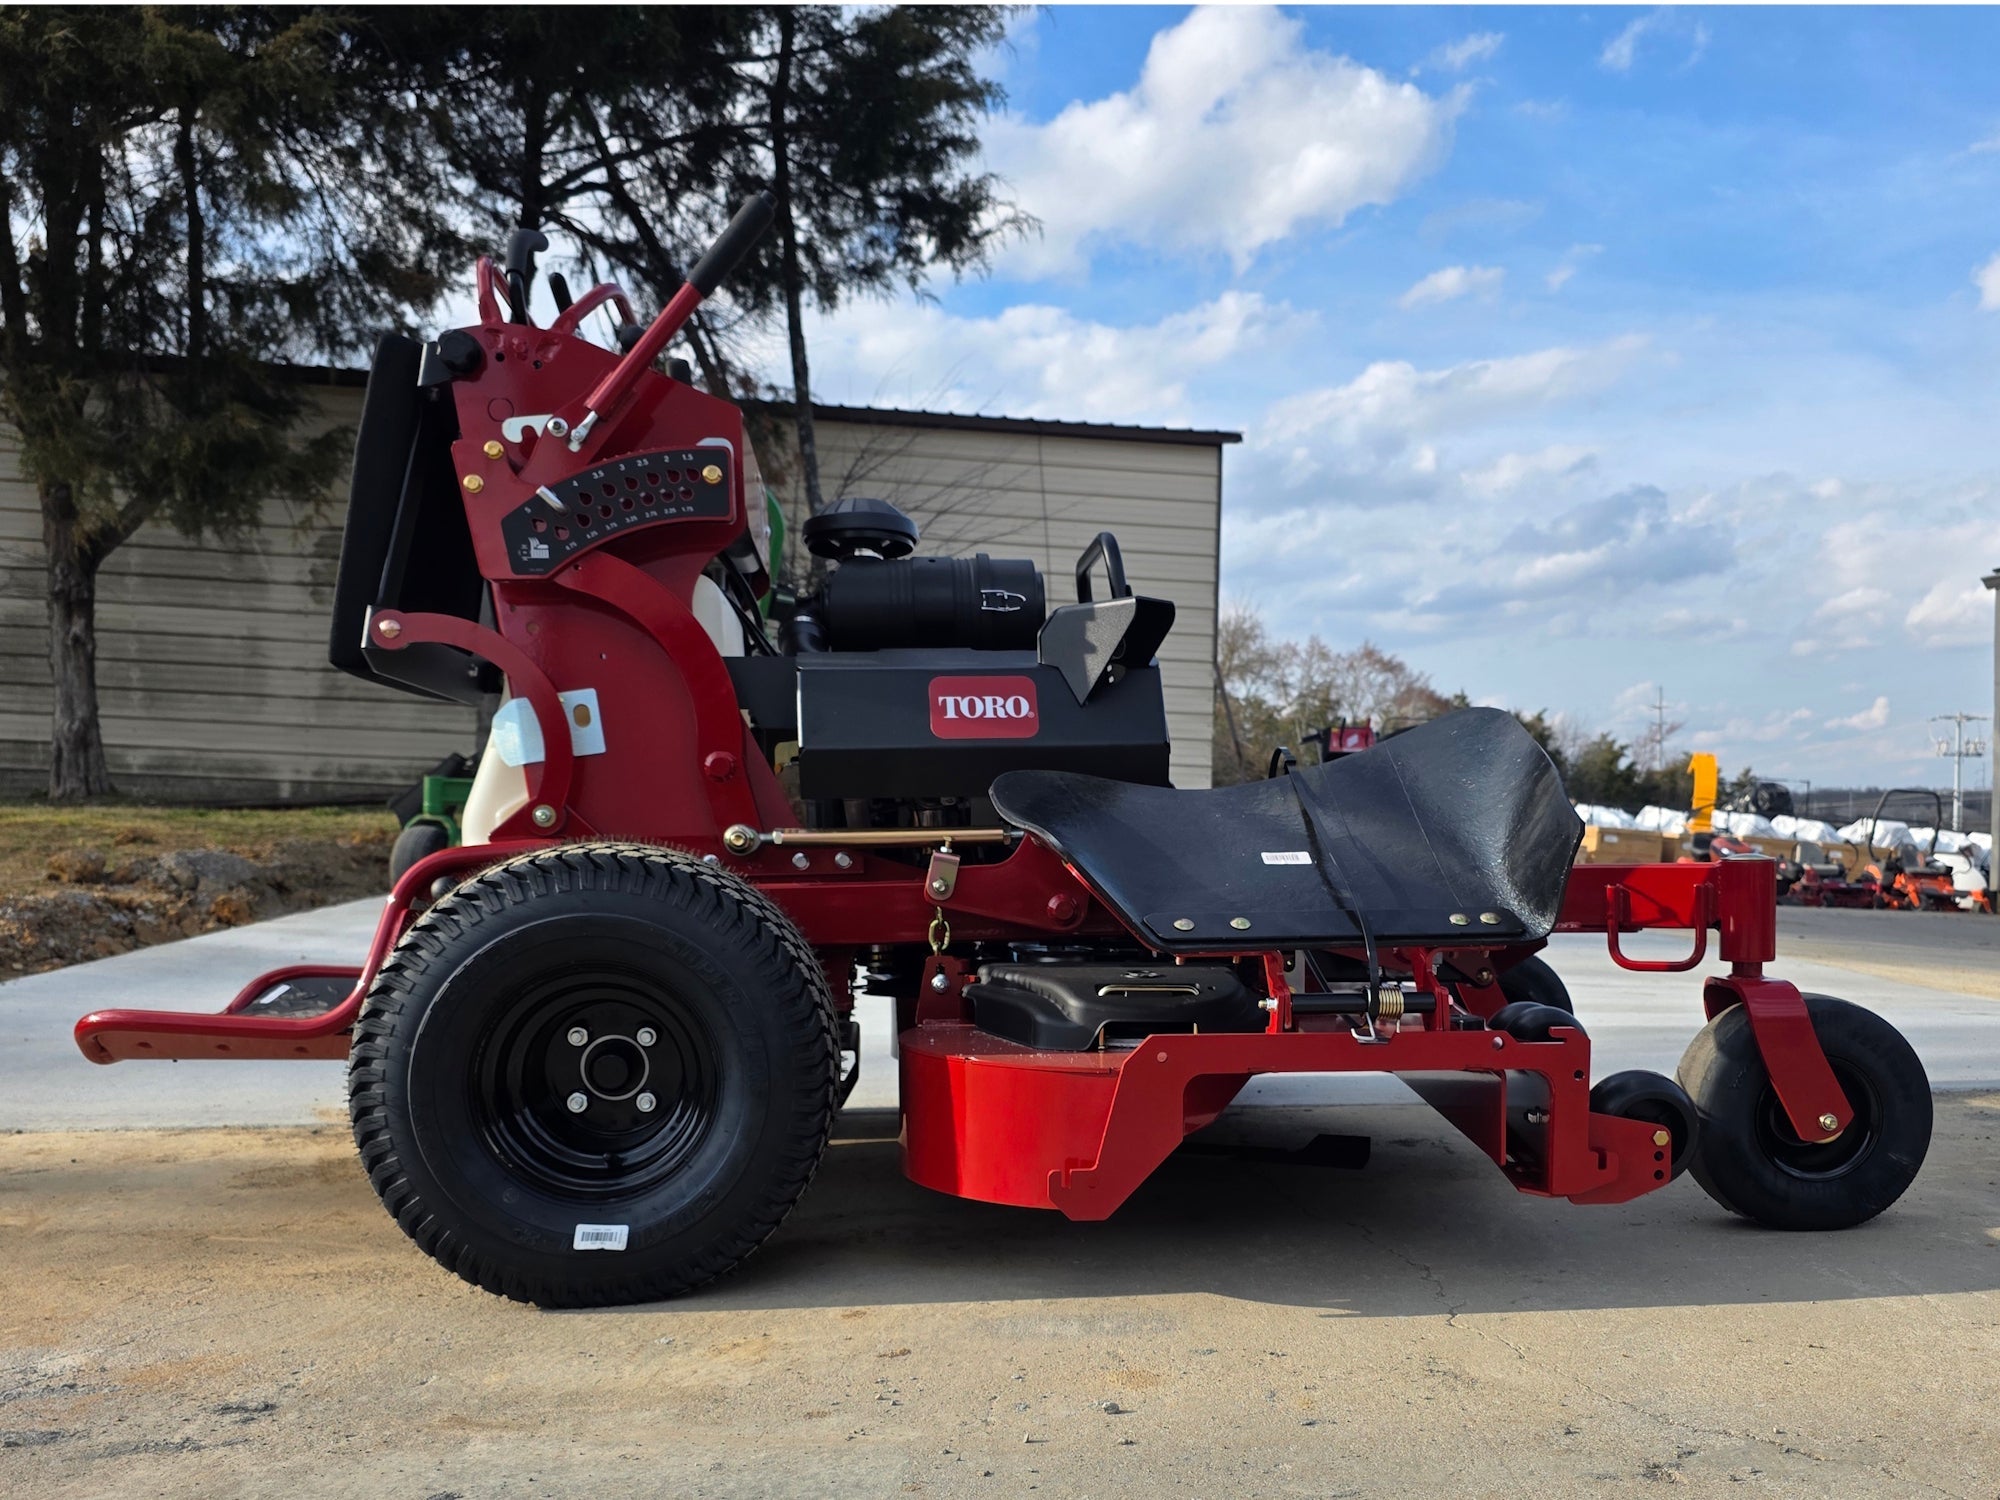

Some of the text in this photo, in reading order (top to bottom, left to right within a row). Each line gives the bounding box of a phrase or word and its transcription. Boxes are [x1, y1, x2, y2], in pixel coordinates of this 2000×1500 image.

[572, 479, 580, 487] 4
[592, 470, 605, 480] 3.5
[619, 463, 626, 471] 3
[636, 458, 649, 467] 2.5
[663, 455, 670, 463] 2
[682, 453, 694, 461] 1.5
[938, 695, 1030, 719] TORO
